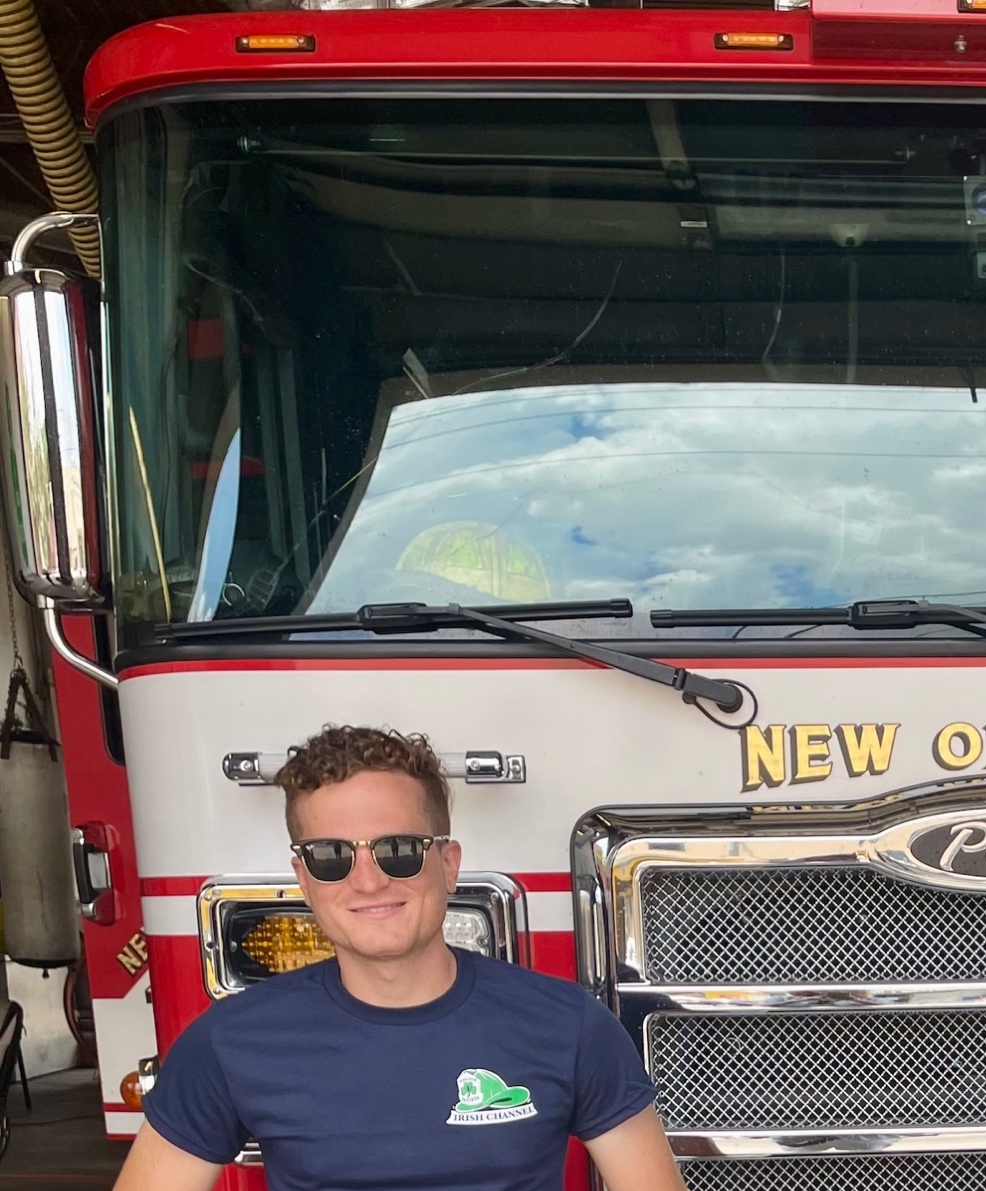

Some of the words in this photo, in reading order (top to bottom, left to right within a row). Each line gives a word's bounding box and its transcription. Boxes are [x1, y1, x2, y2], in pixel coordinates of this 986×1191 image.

[740, 722, 902, 793] NEW
[116, 927, 148, 976] NE
[453, 1114, 484, 1122] IRISH
[486, 1106, 535, 1121] CHANNEL
